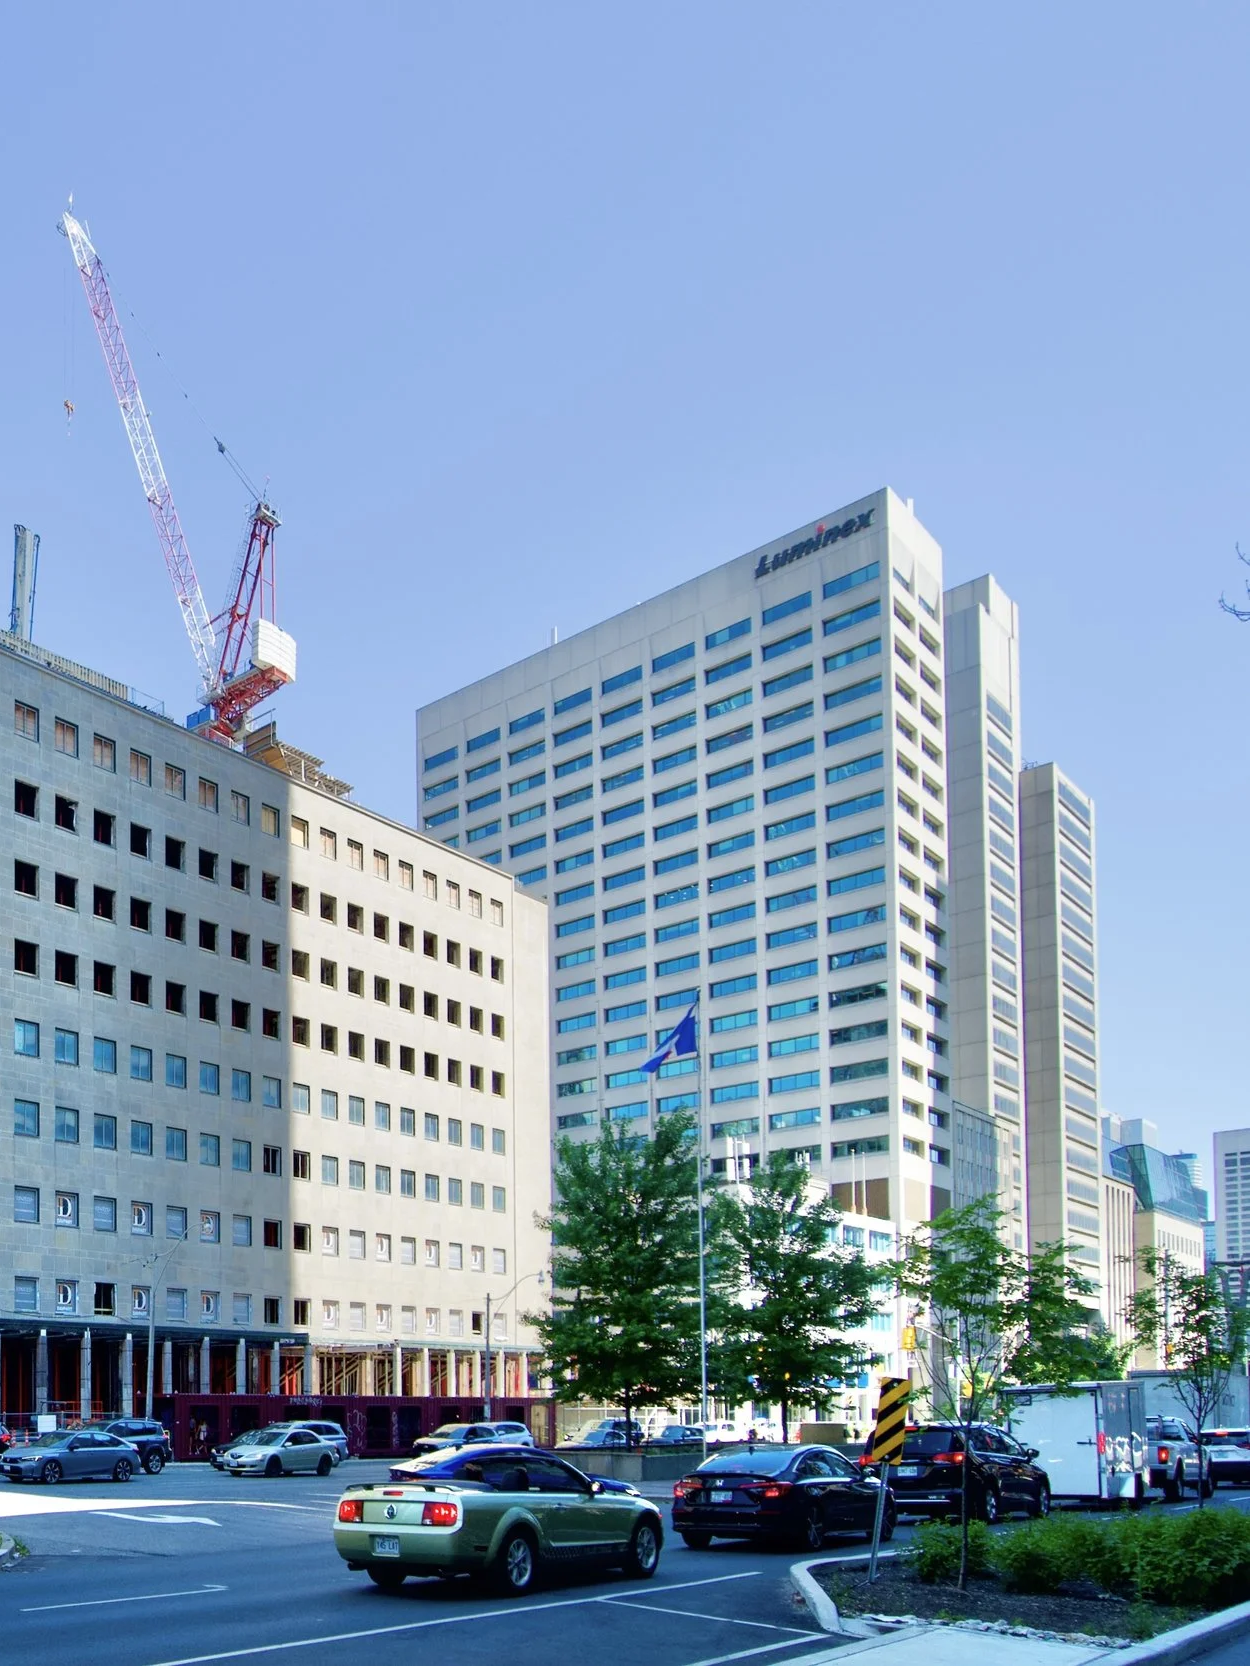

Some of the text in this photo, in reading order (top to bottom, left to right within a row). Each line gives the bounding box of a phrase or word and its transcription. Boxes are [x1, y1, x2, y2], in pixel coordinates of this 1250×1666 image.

[754, 508, 876, 579] Luminex
[57, 1197, 72, 1217] D
[57, 1284, 72, 1305] D
